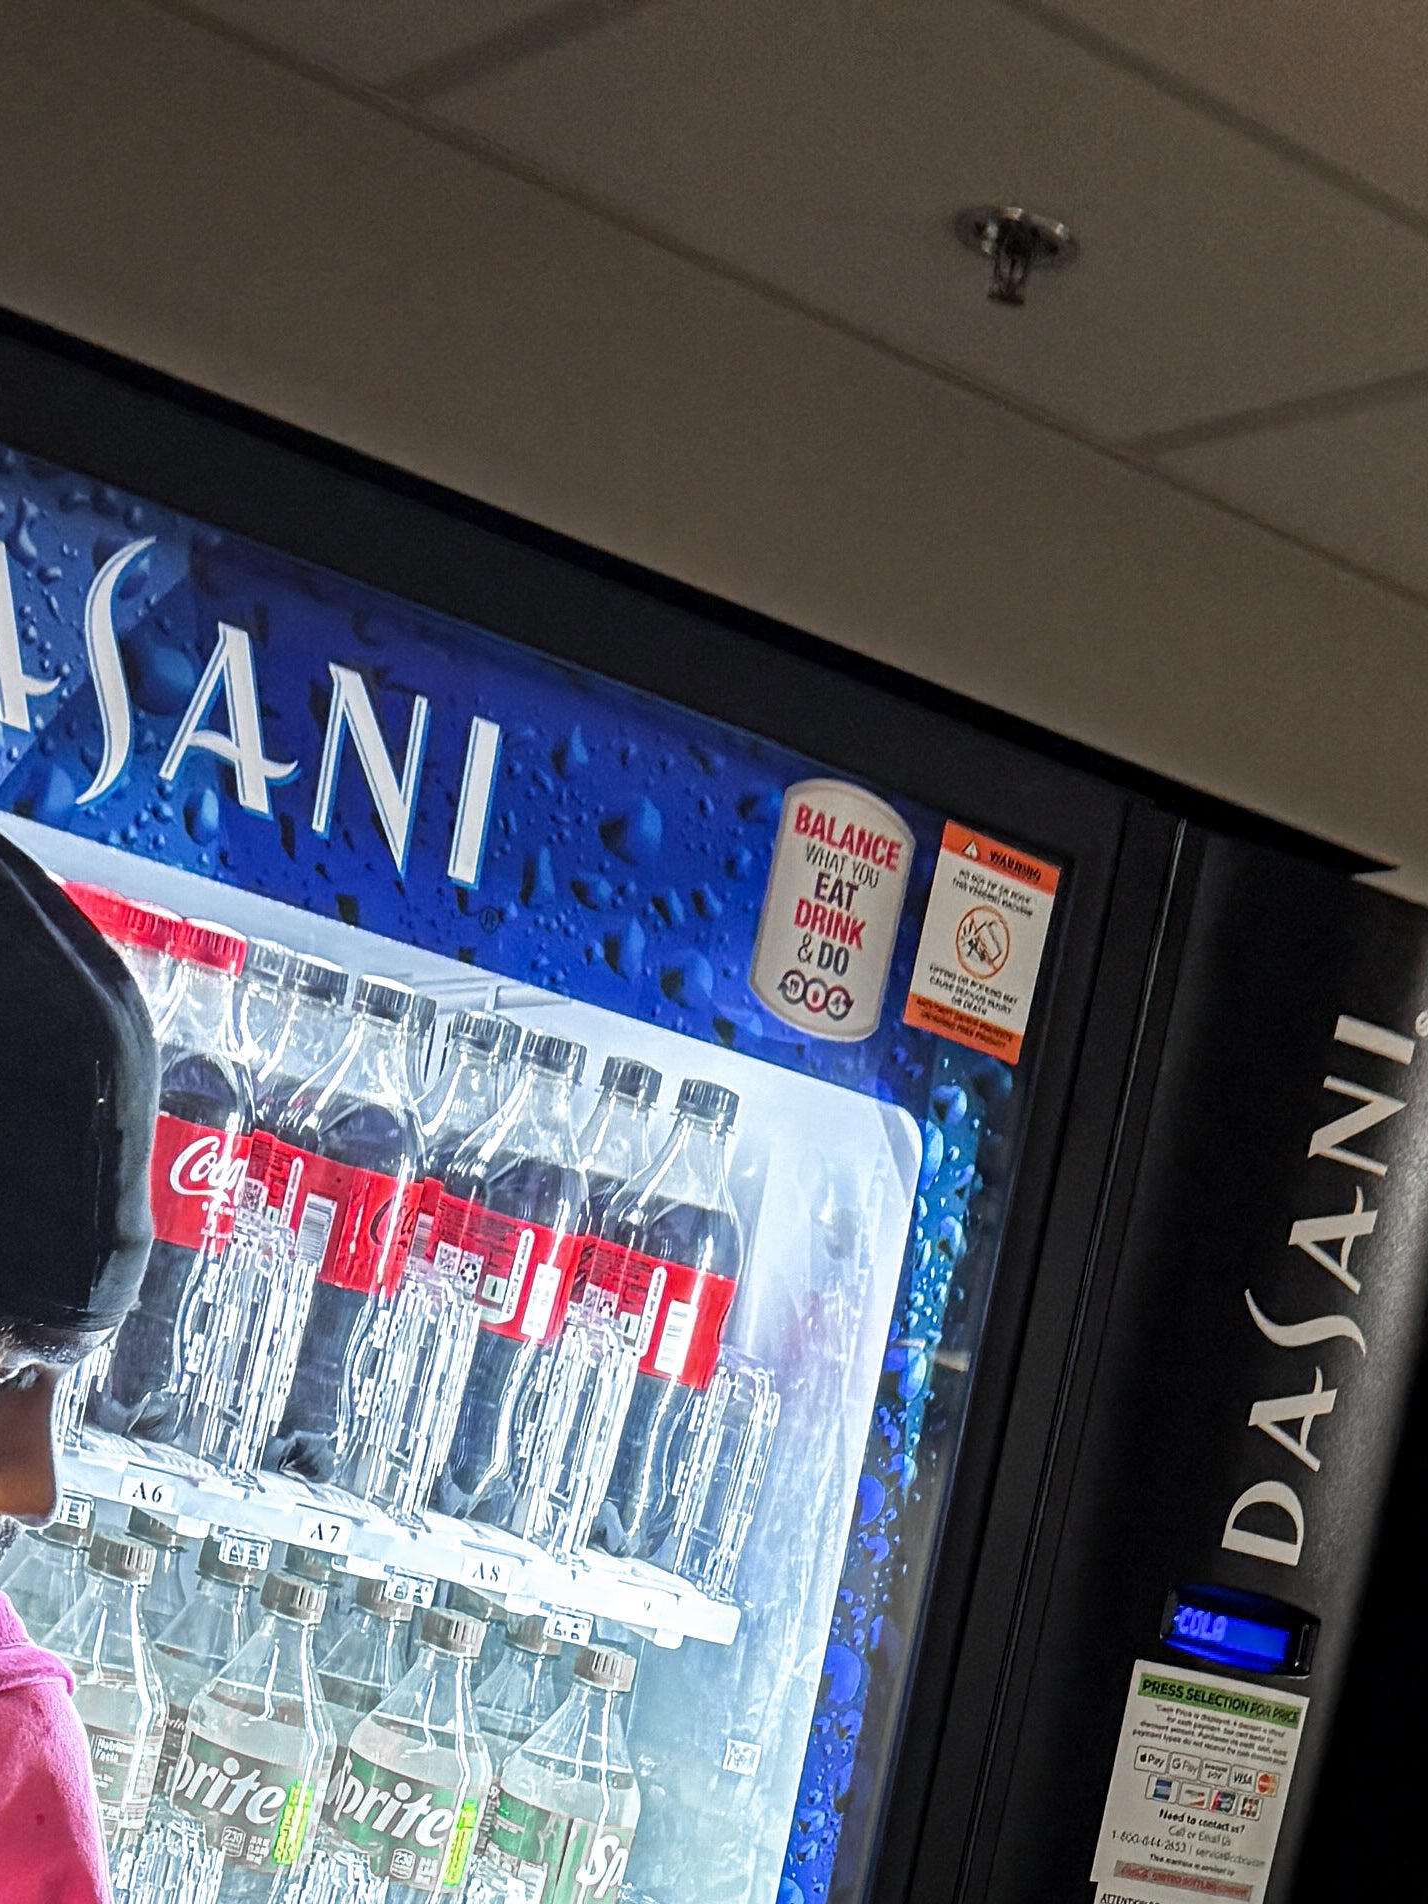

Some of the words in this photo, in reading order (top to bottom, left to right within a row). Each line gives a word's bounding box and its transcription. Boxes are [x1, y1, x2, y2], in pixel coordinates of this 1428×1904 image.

[794, 803, 902, 872] BALANCE
[806, 842, 847, 875] WHAT
[853, 859, 879, 889] YOU
[815, 872, 858, 911] EAT
[794, 898, 865, 950] DRINK
[797, 932, 813, 964] &
[817, 940, 850, 976] DO
[1219, 1013, 1416, 1568] DASANI
[1141, 1678, 1184, 1699] PRESS
[1185, 1685, 1250, 1714] SELECTION
[1250, 1700, 1273, 1719] FOR
[1273, 1706, 1301, 1725] PRICE
[1148, 1754, 1165, 1768] Pay
[1172, 1757, 1181, 1770] G
[1182, 1760, 1199, 1776] Pay
[1233, 1771, 1253, 1785] VISA
[1159, 1809, 1184, 1823] Need
[1186, 1815, 1197, 1825] to
